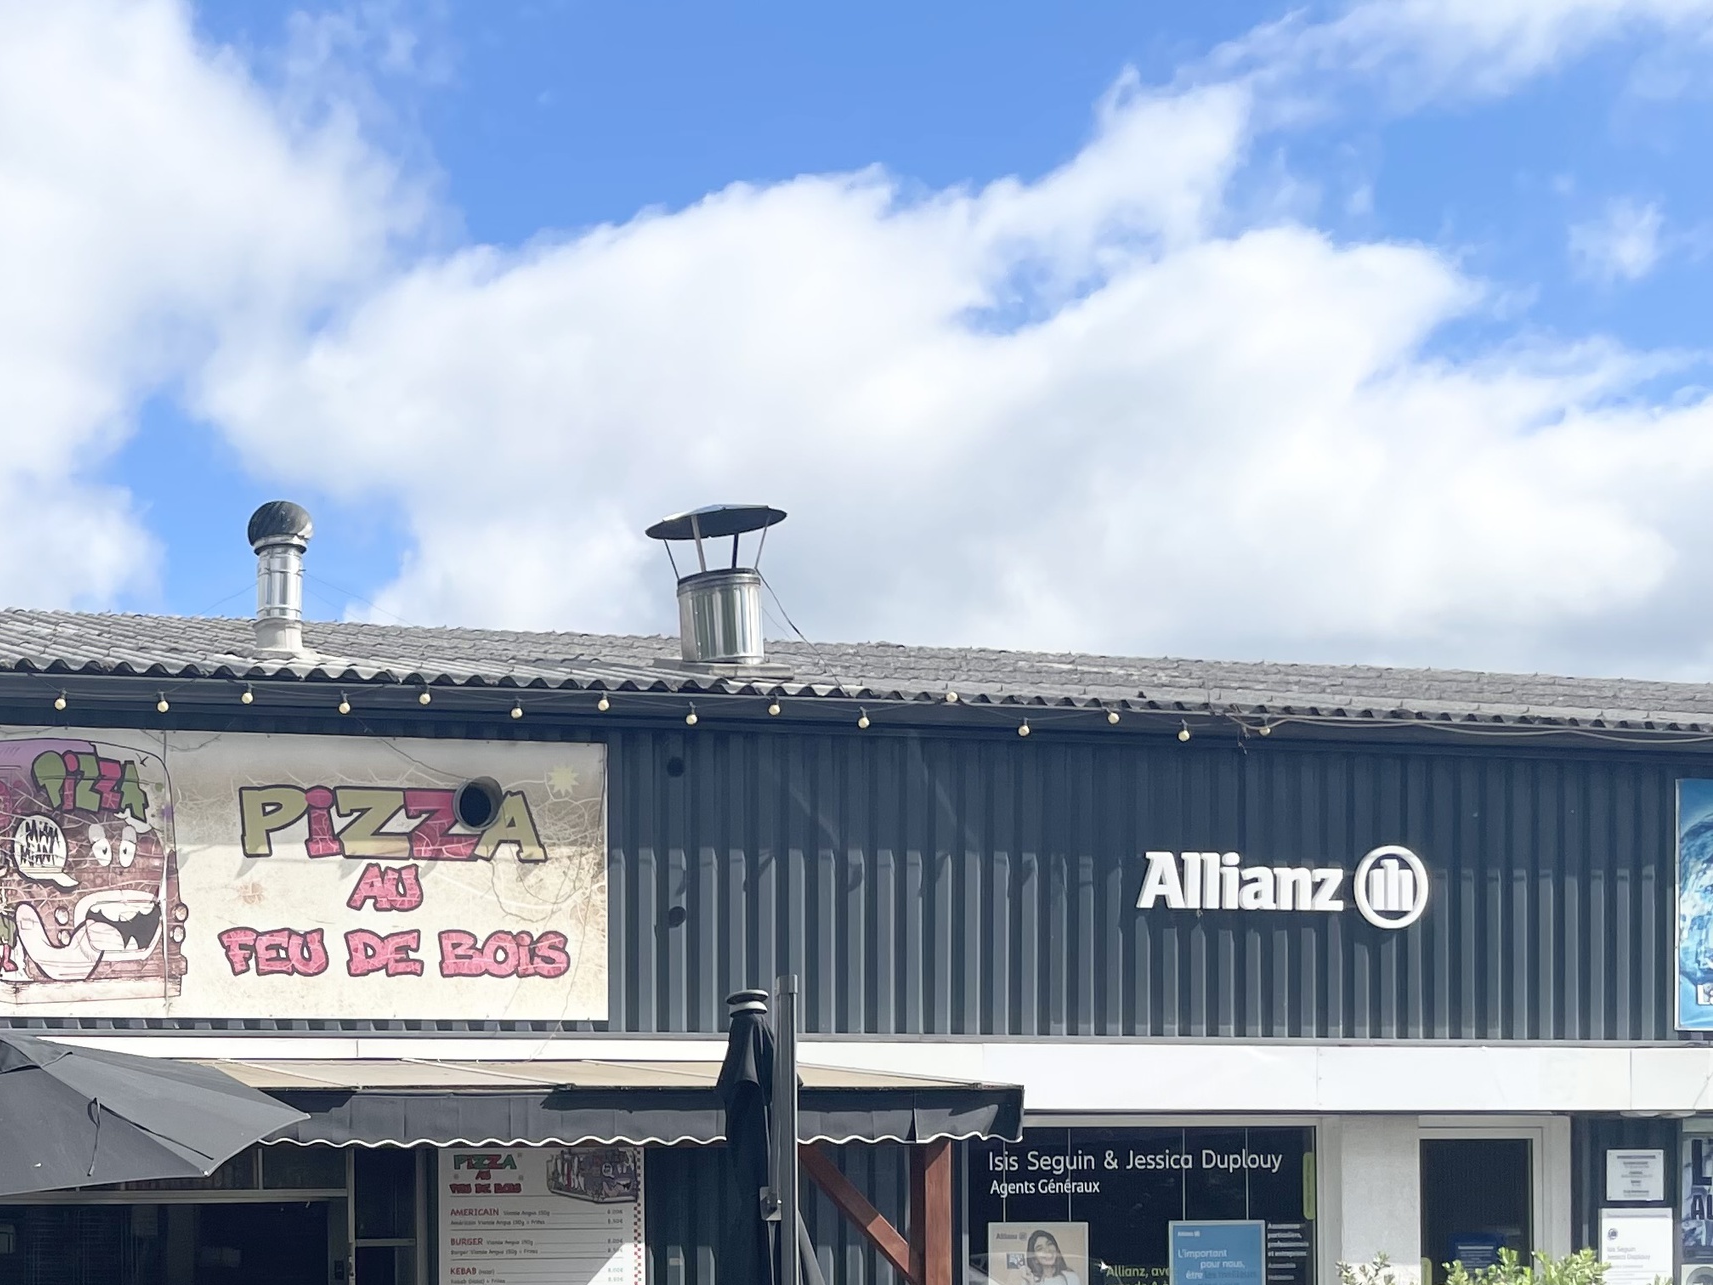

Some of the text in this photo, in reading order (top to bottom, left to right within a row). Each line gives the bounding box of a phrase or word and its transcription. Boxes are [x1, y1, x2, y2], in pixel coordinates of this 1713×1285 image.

[346, 862, 423, 911] AU
[1136, 851, 1343, 911] Allianz
[218, 927, 329, 976] FEU
[344, 929, 424, 976] DE
[989, 1148, 1283, 1174] Isis Seguin & Jessica Duplouy
[990, 1178, 1100, 1198] Agents Généraux
[450, 1237, 484, 1246] BURGER
[450, 1267, 477, 1275] KEBAB
[1106, 1265, 1148, 1279] Allianz,
